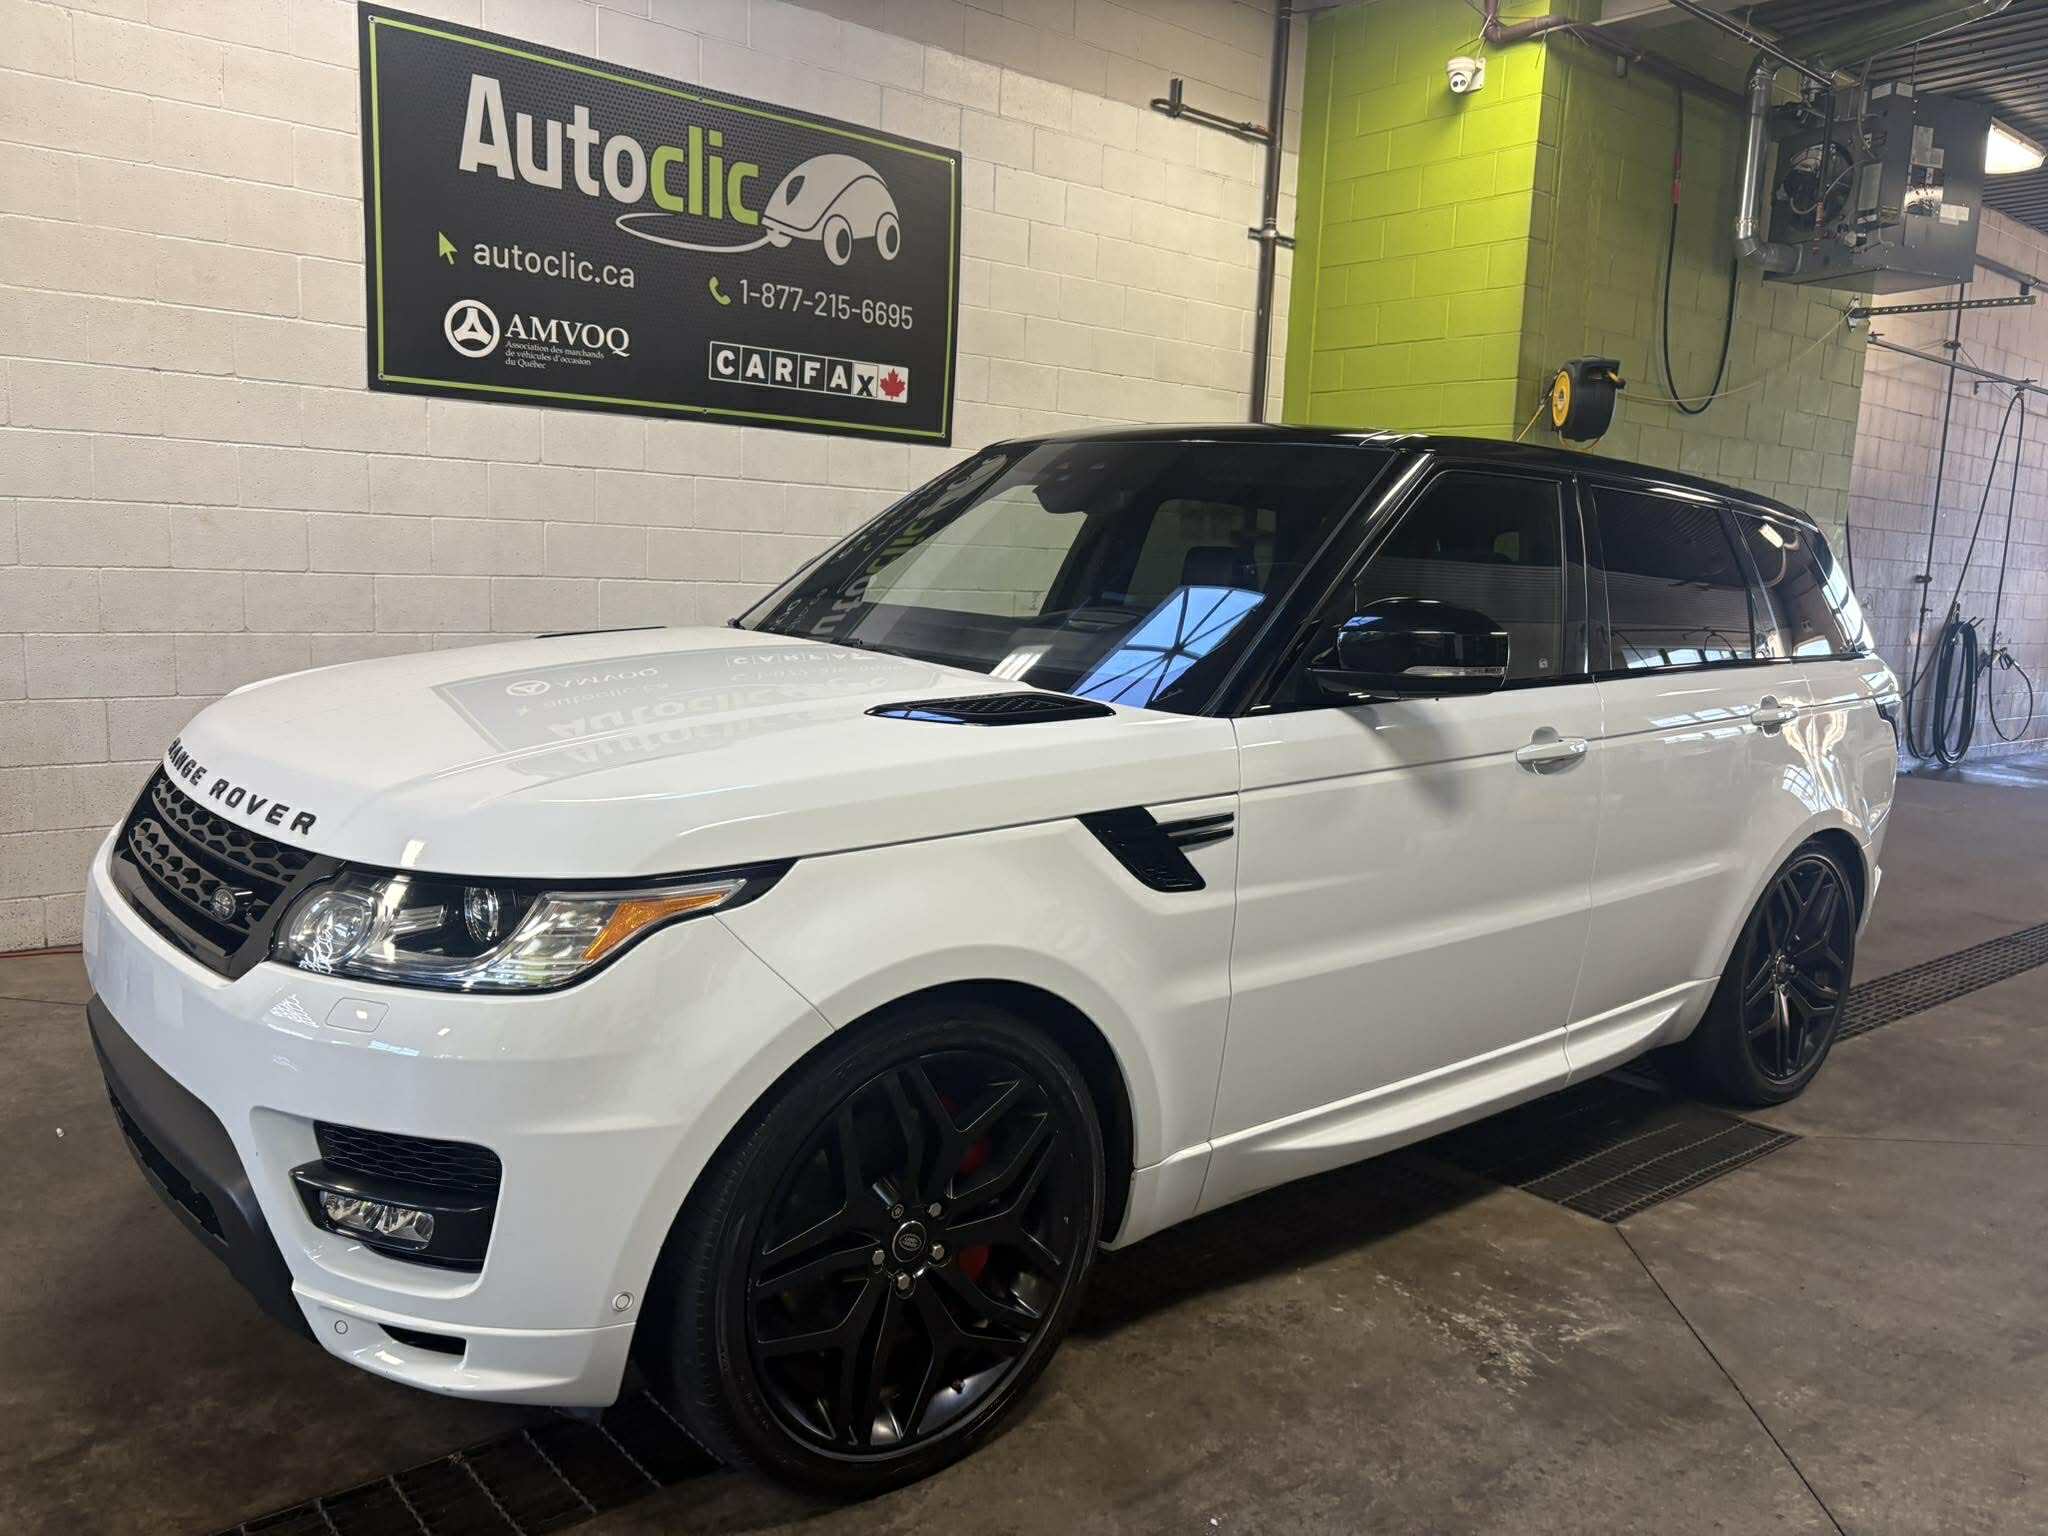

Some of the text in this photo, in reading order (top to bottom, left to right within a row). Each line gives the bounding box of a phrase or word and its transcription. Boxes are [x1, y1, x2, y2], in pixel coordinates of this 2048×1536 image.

[459, 73, 760, 226] Autoclic
[472, 242, 635, 289] autoclic.ca
[740, 279, 914, 330] 1-877-215-6695
[505, 313, 631, 358] AMVOQ
[505, 341, 549, 352] Association
[564, 349, 605, 359] marchands
[505, 358, 516, 366] du
[715, 349, 874, 398] CARFAX
[168, 737, 317, 836] RANGE ROVER
